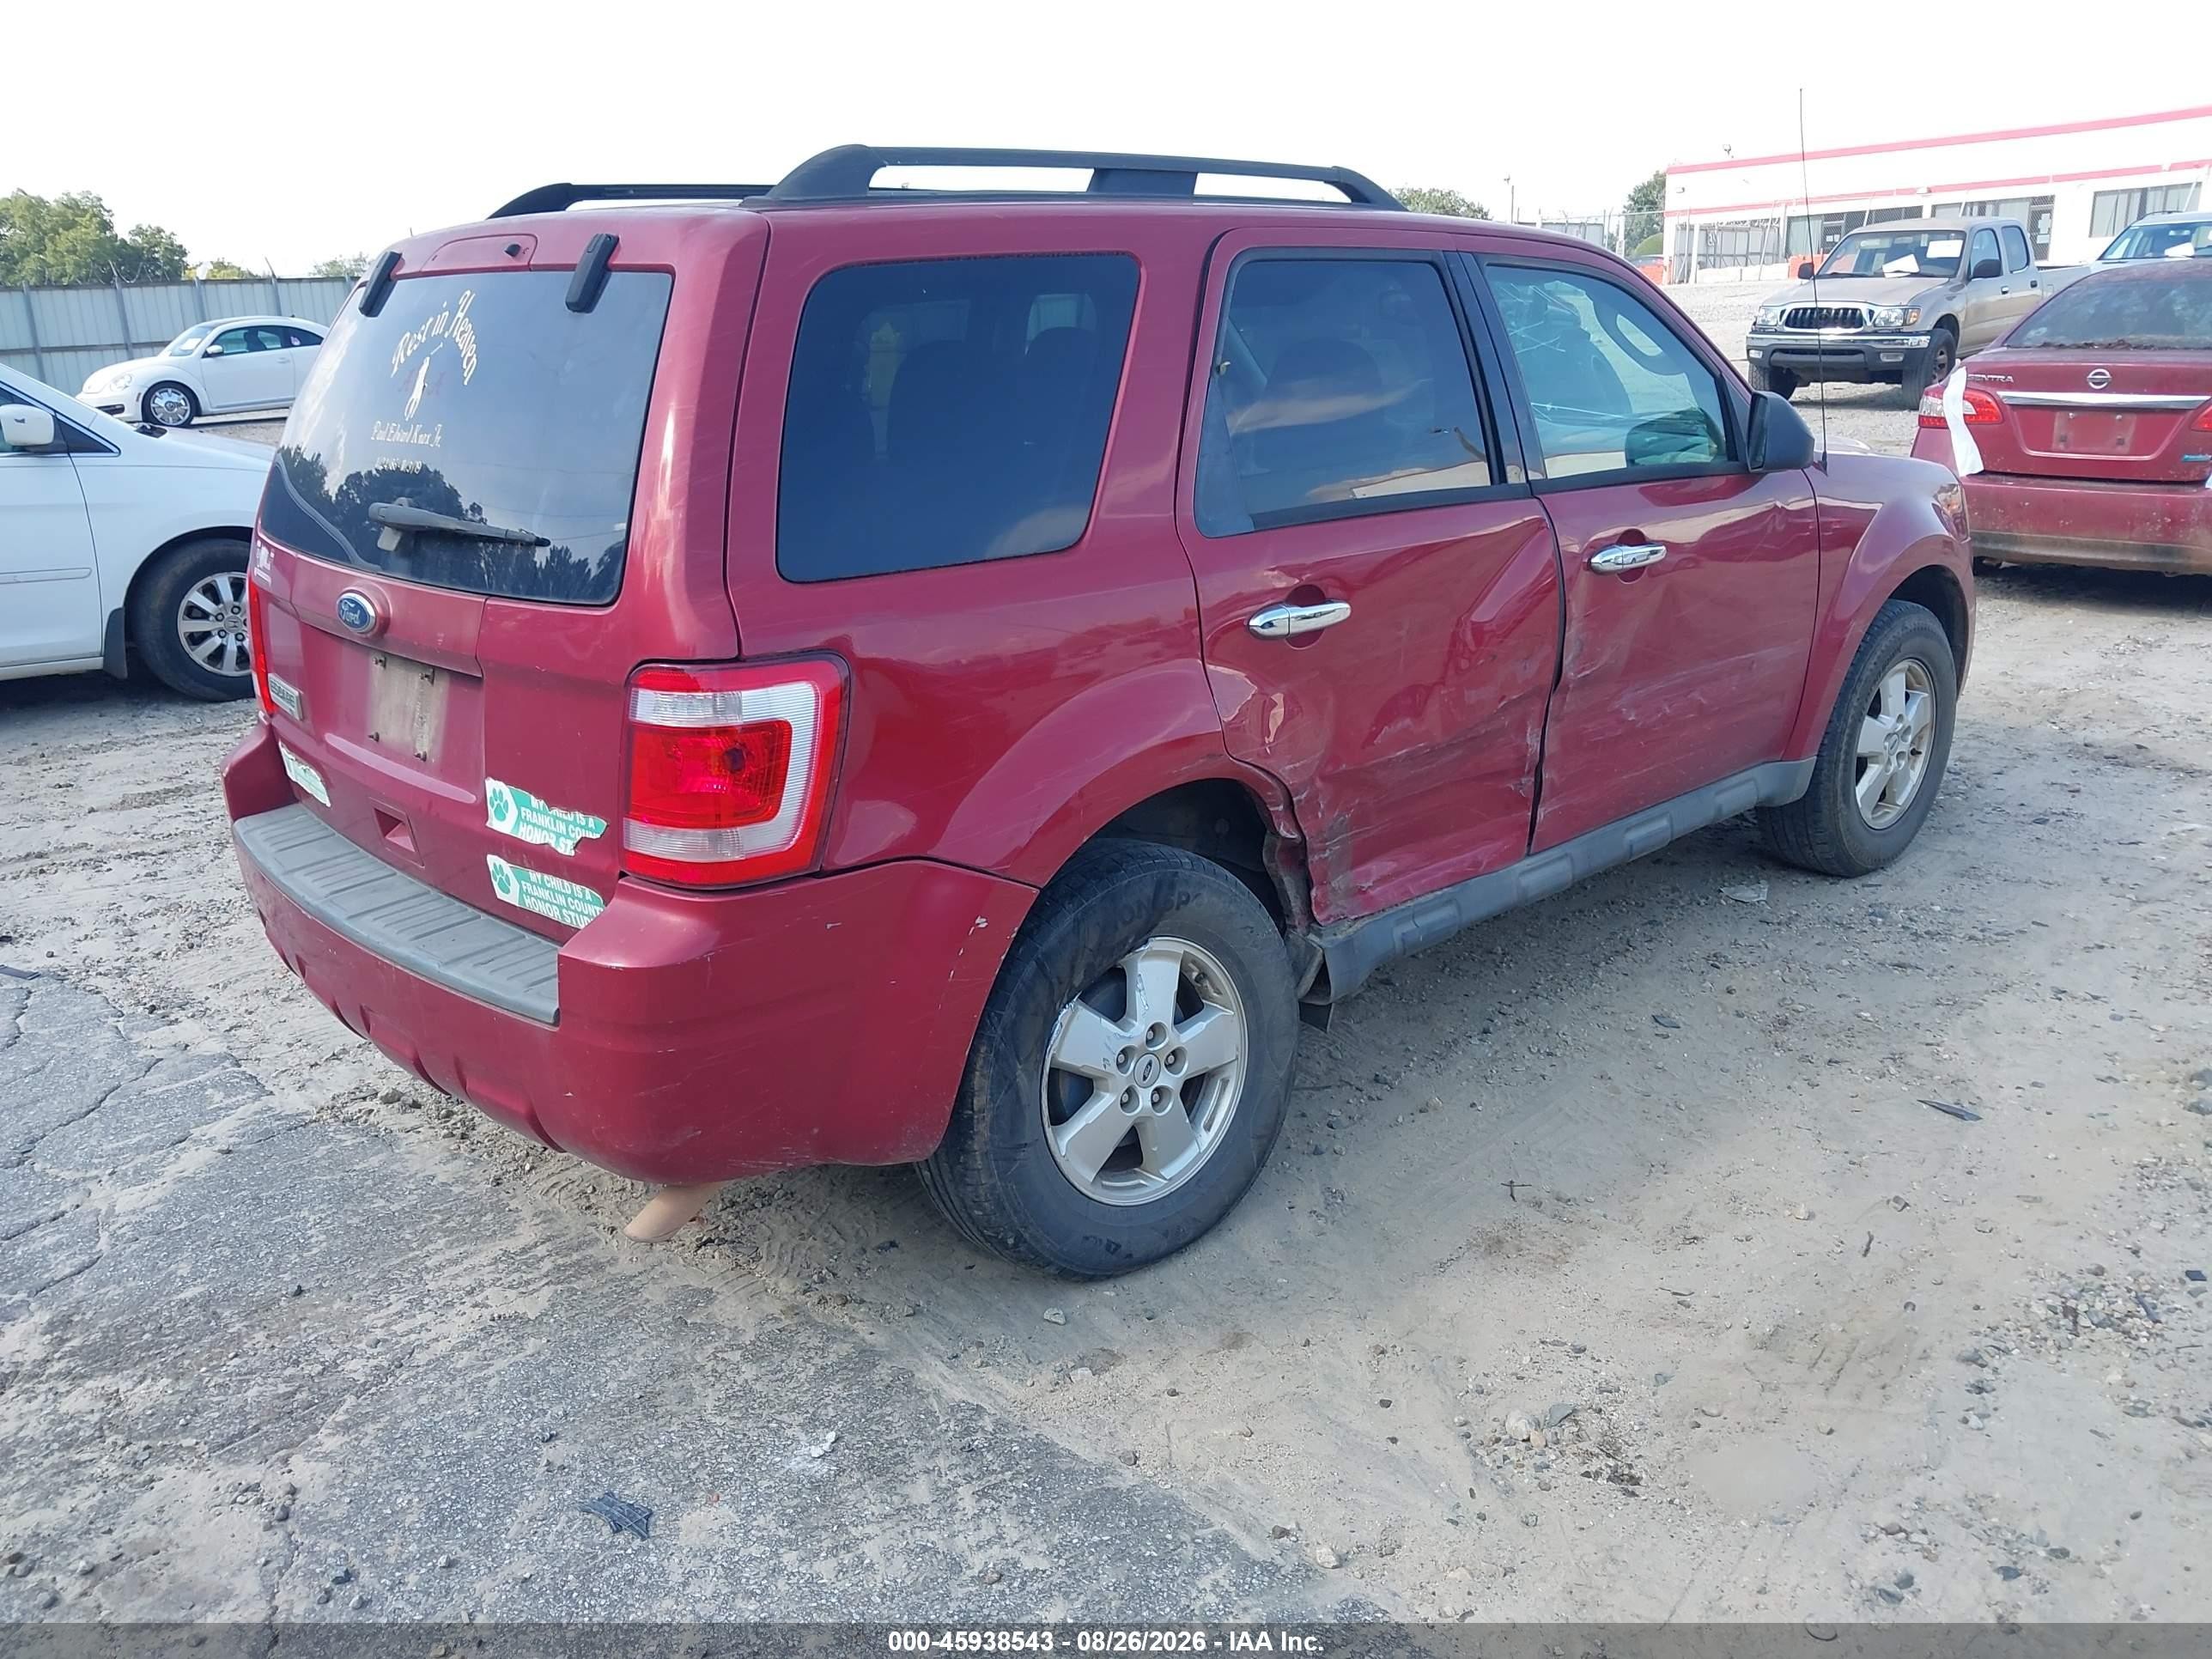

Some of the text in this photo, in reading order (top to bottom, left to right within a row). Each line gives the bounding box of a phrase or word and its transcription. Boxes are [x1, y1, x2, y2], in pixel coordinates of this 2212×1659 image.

[391, 289, 477, 386] Rest in Heaven
[520, 806, 567, 836] FRANKLIN
[588, 817, 596, 830] A
[520, 879, 567, 908] FRANKLIN
[528, 870, 593, 902] MY CHILD IS A
[522, 893, 562, 921] HONOR
